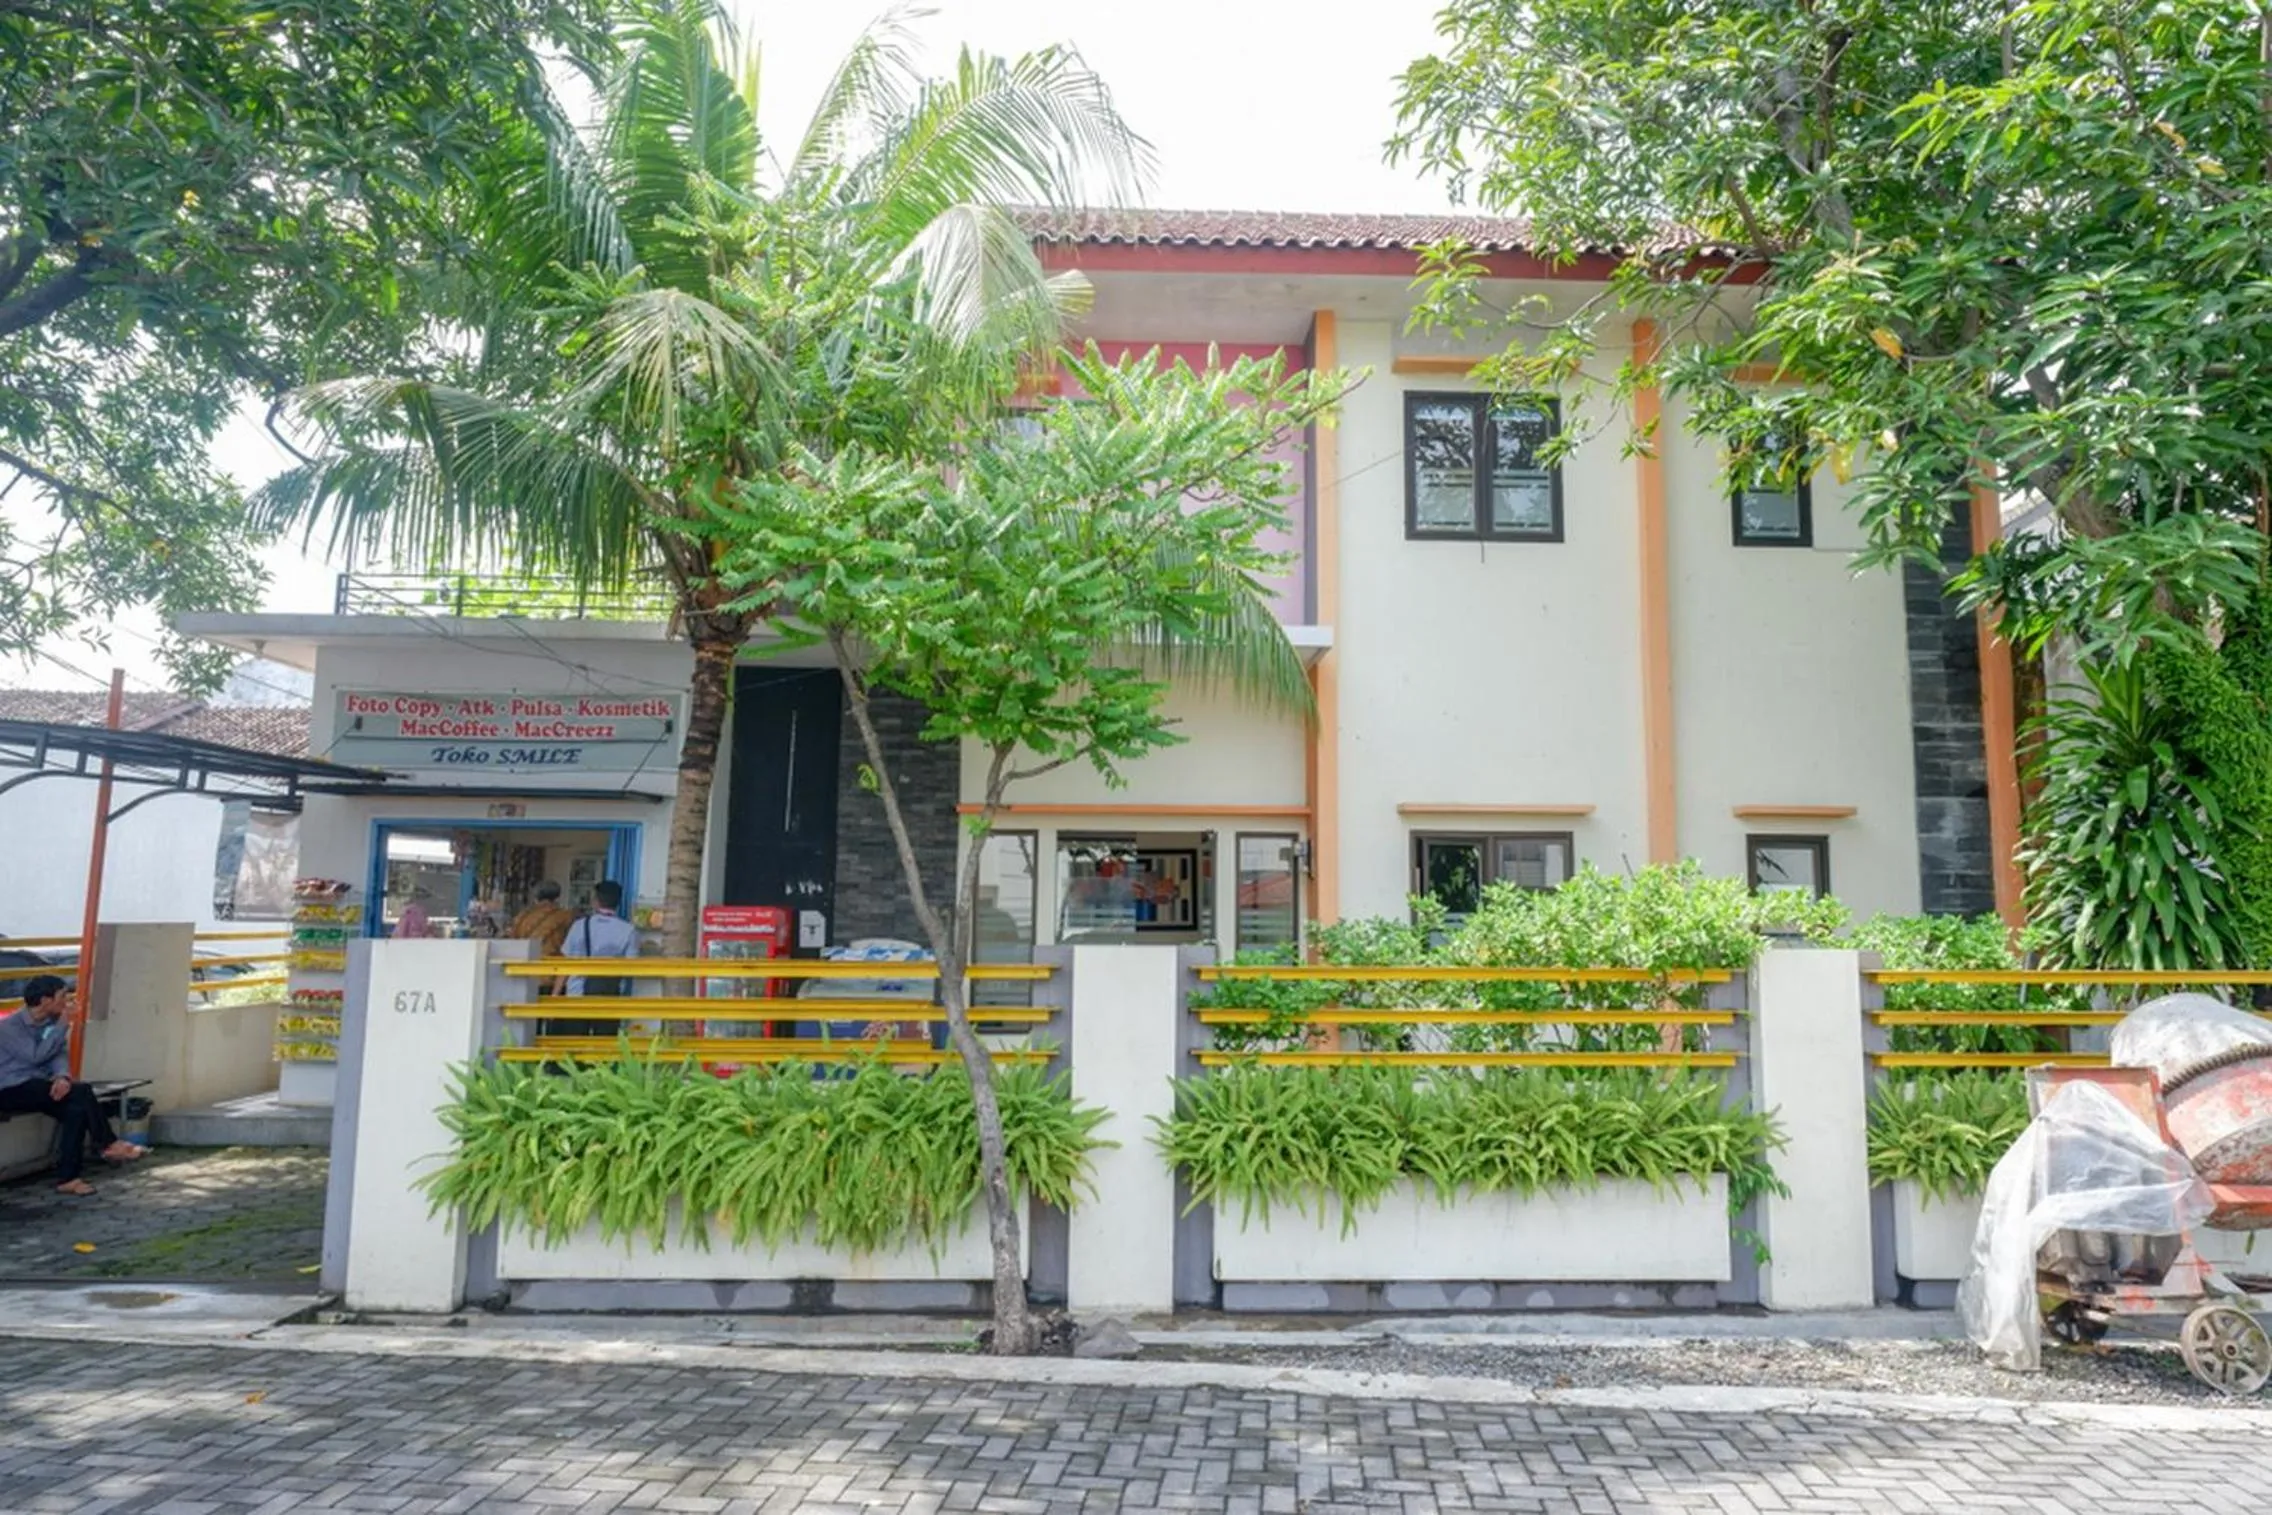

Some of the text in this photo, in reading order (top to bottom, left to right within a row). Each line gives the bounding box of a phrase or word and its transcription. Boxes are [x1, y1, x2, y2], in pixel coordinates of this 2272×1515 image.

[346, 694, 671, 718] Foto Copy Atk Pulsa Kosmetik
[400, 718, 615, 738] MacCoffee MacCreezz
[431, 746, 583, 765] Toko SMILE
[393, 990, 437, 1014] 67A
